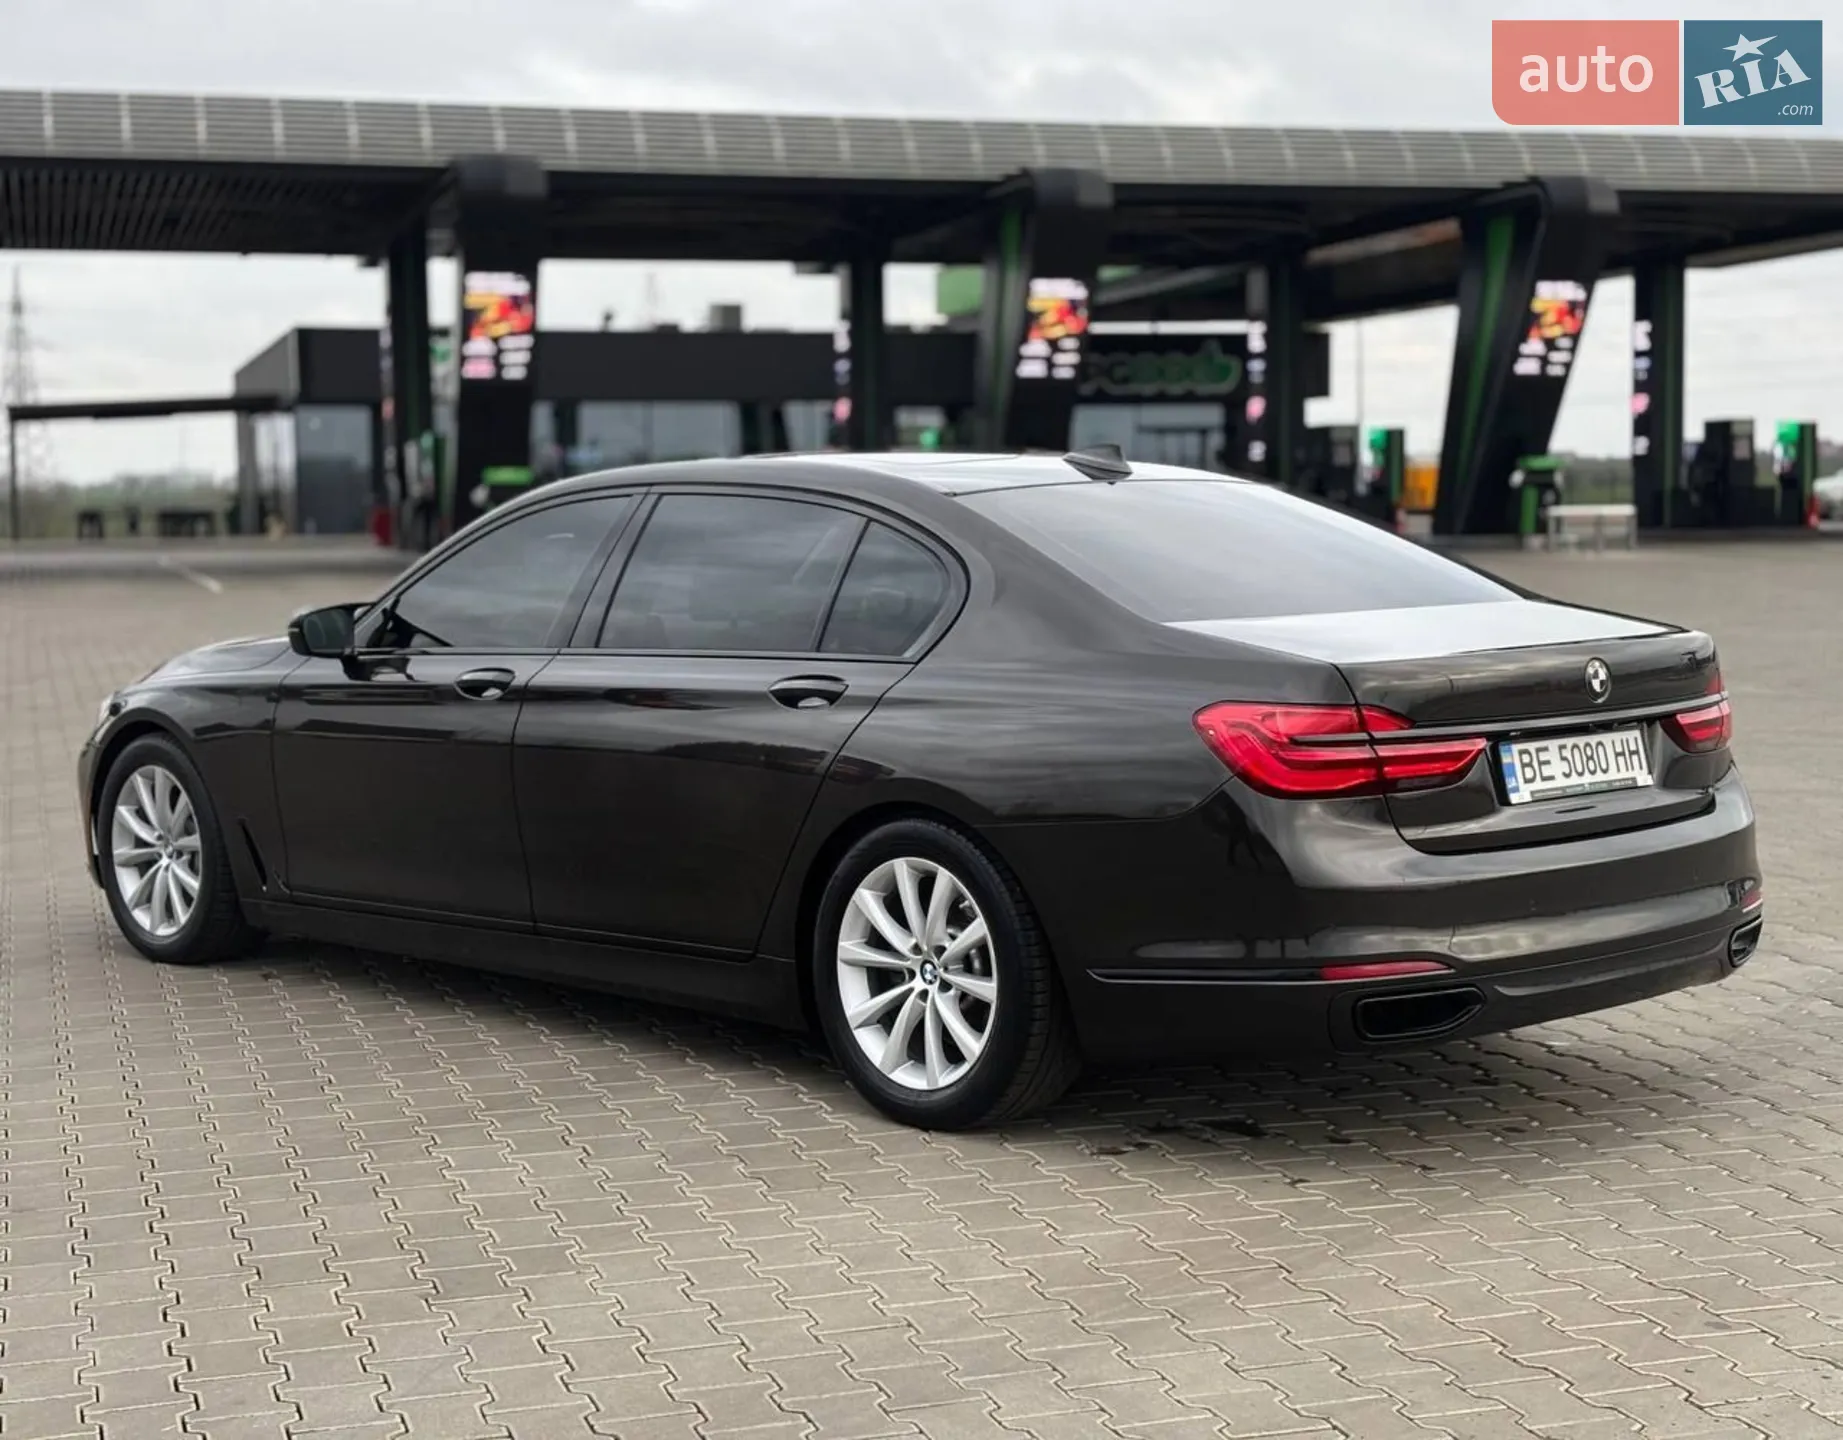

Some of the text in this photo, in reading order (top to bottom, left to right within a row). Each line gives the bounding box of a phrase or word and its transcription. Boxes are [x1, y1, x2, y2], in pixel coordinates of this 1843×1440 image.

[1518, 736, 1644, 784] BE 5080 HH
